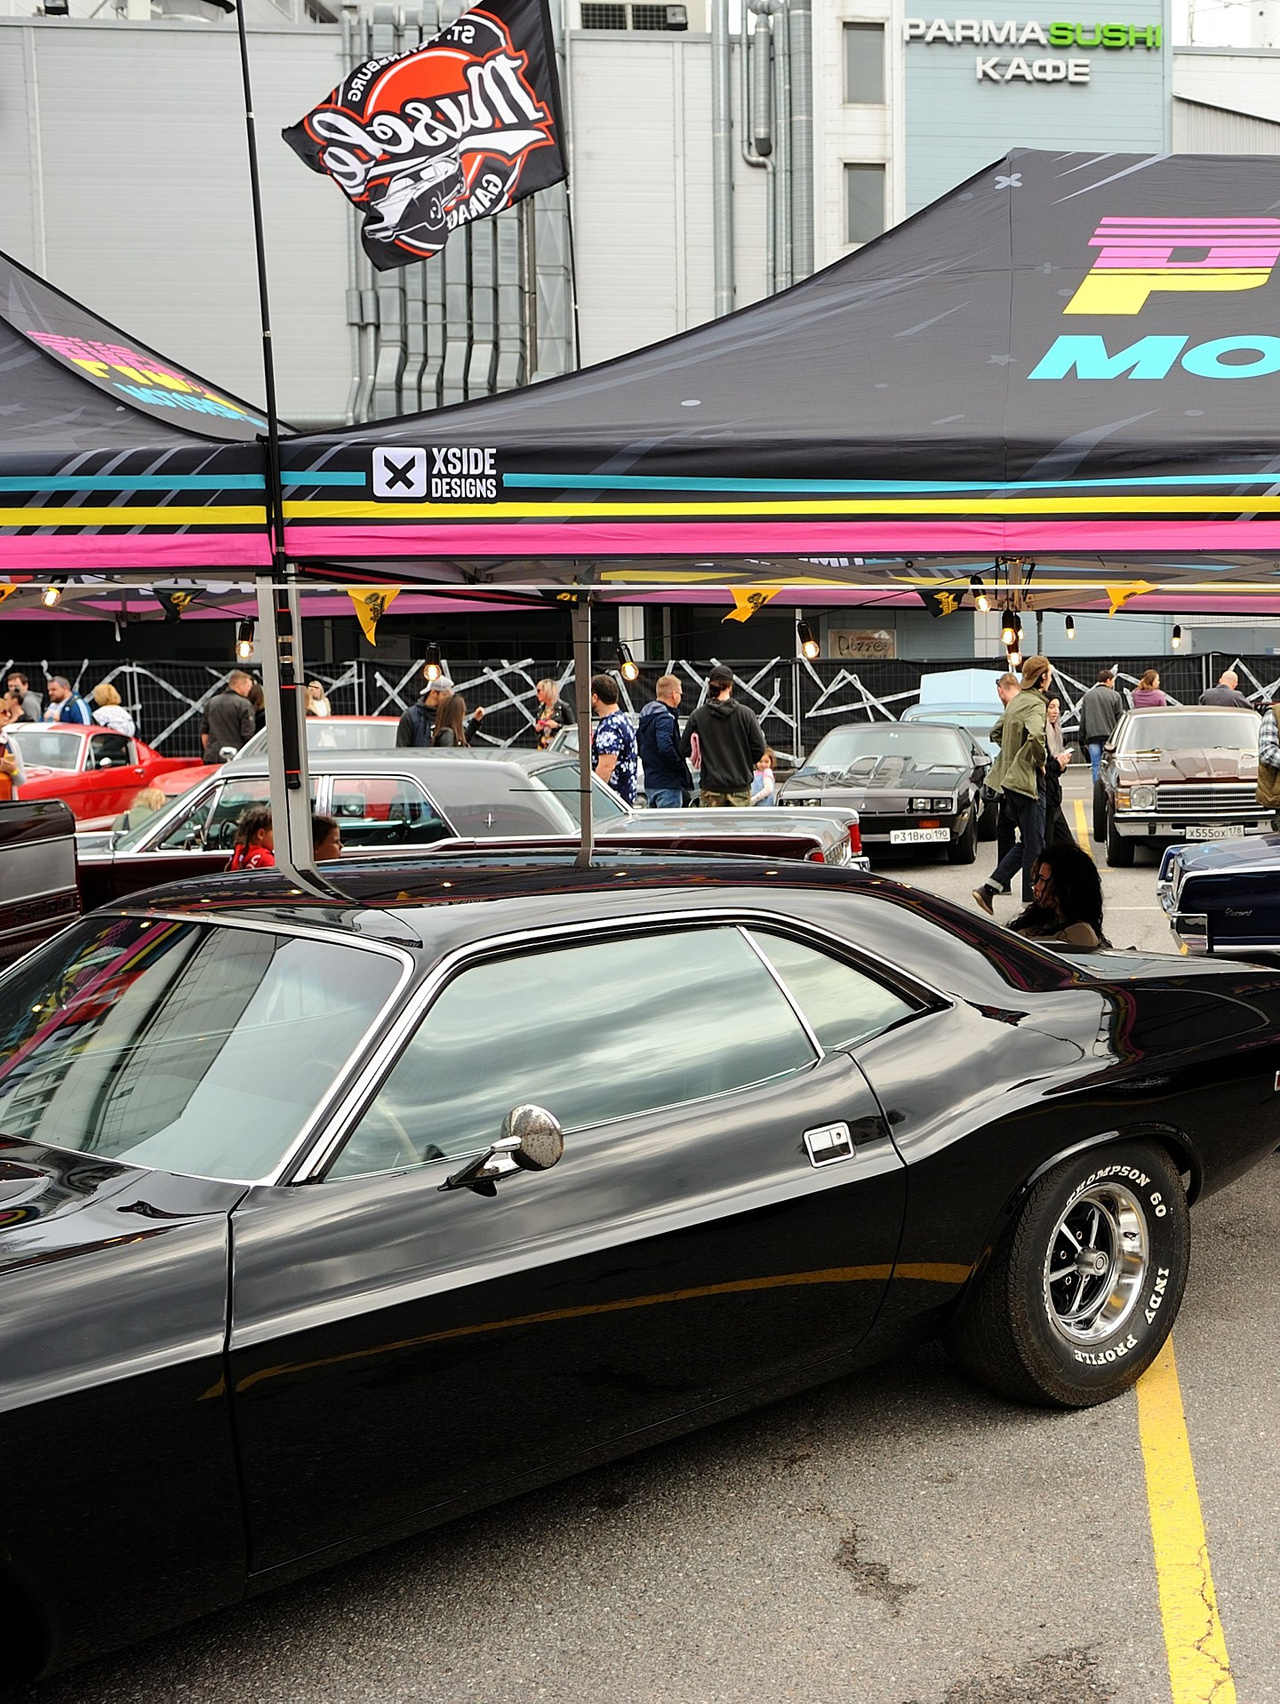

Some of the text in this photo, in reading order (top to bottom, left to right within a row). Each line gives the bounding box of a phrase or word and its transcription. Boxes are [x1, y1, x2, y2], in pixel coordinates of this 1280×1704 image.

[976, 57, 1091, 83] КАФЕ
[431, 447, 497, 475] XSIDE
[431, 478, 497, 498] DESIGNS
[1149, 1191, 1167, 1218] 60
[1144, 1267, 1169, 1325] INDY
[1073, 1333, 1138, 1365] PROFILE
